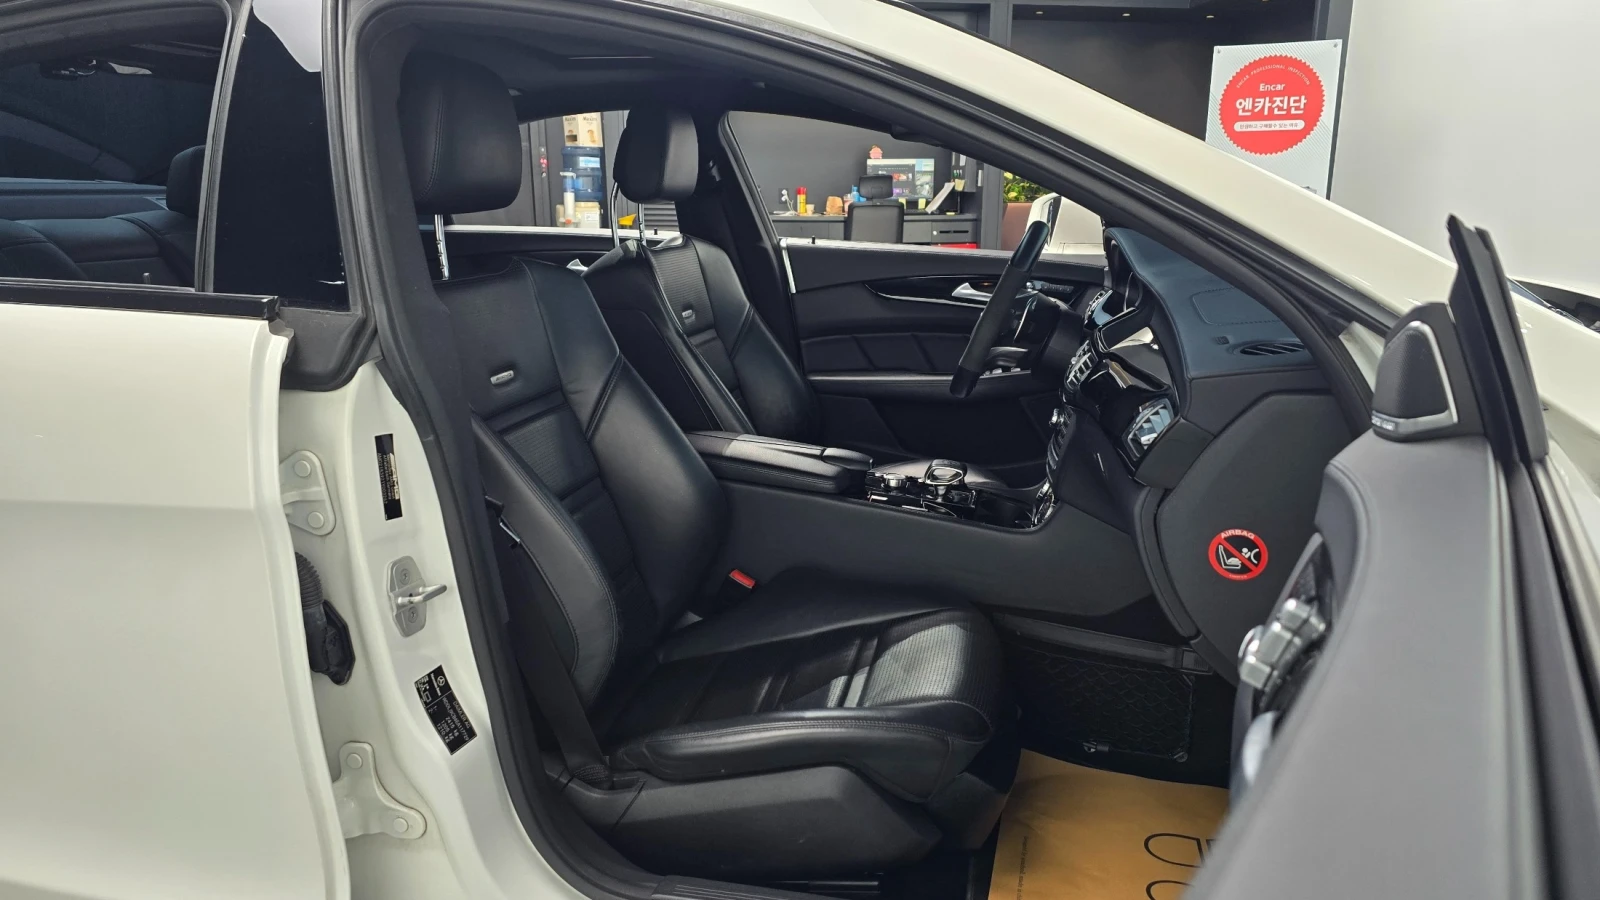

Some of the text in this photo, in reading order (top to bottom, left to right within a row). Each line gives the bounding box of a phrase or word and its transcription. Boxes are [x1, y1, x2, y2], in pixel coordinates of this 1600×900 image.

[1251, 64, 1286, 76] PROFESSIONAL
[1288, 66, 1310, 86] INSPECTION
[1259, 82, 1285, 92] Encar
[1236, 95, 1307, 116] 엔카진단
[1221, 529, 1256, 540] AIRBAG
[453, 700, 466, 722] DAIMLER
